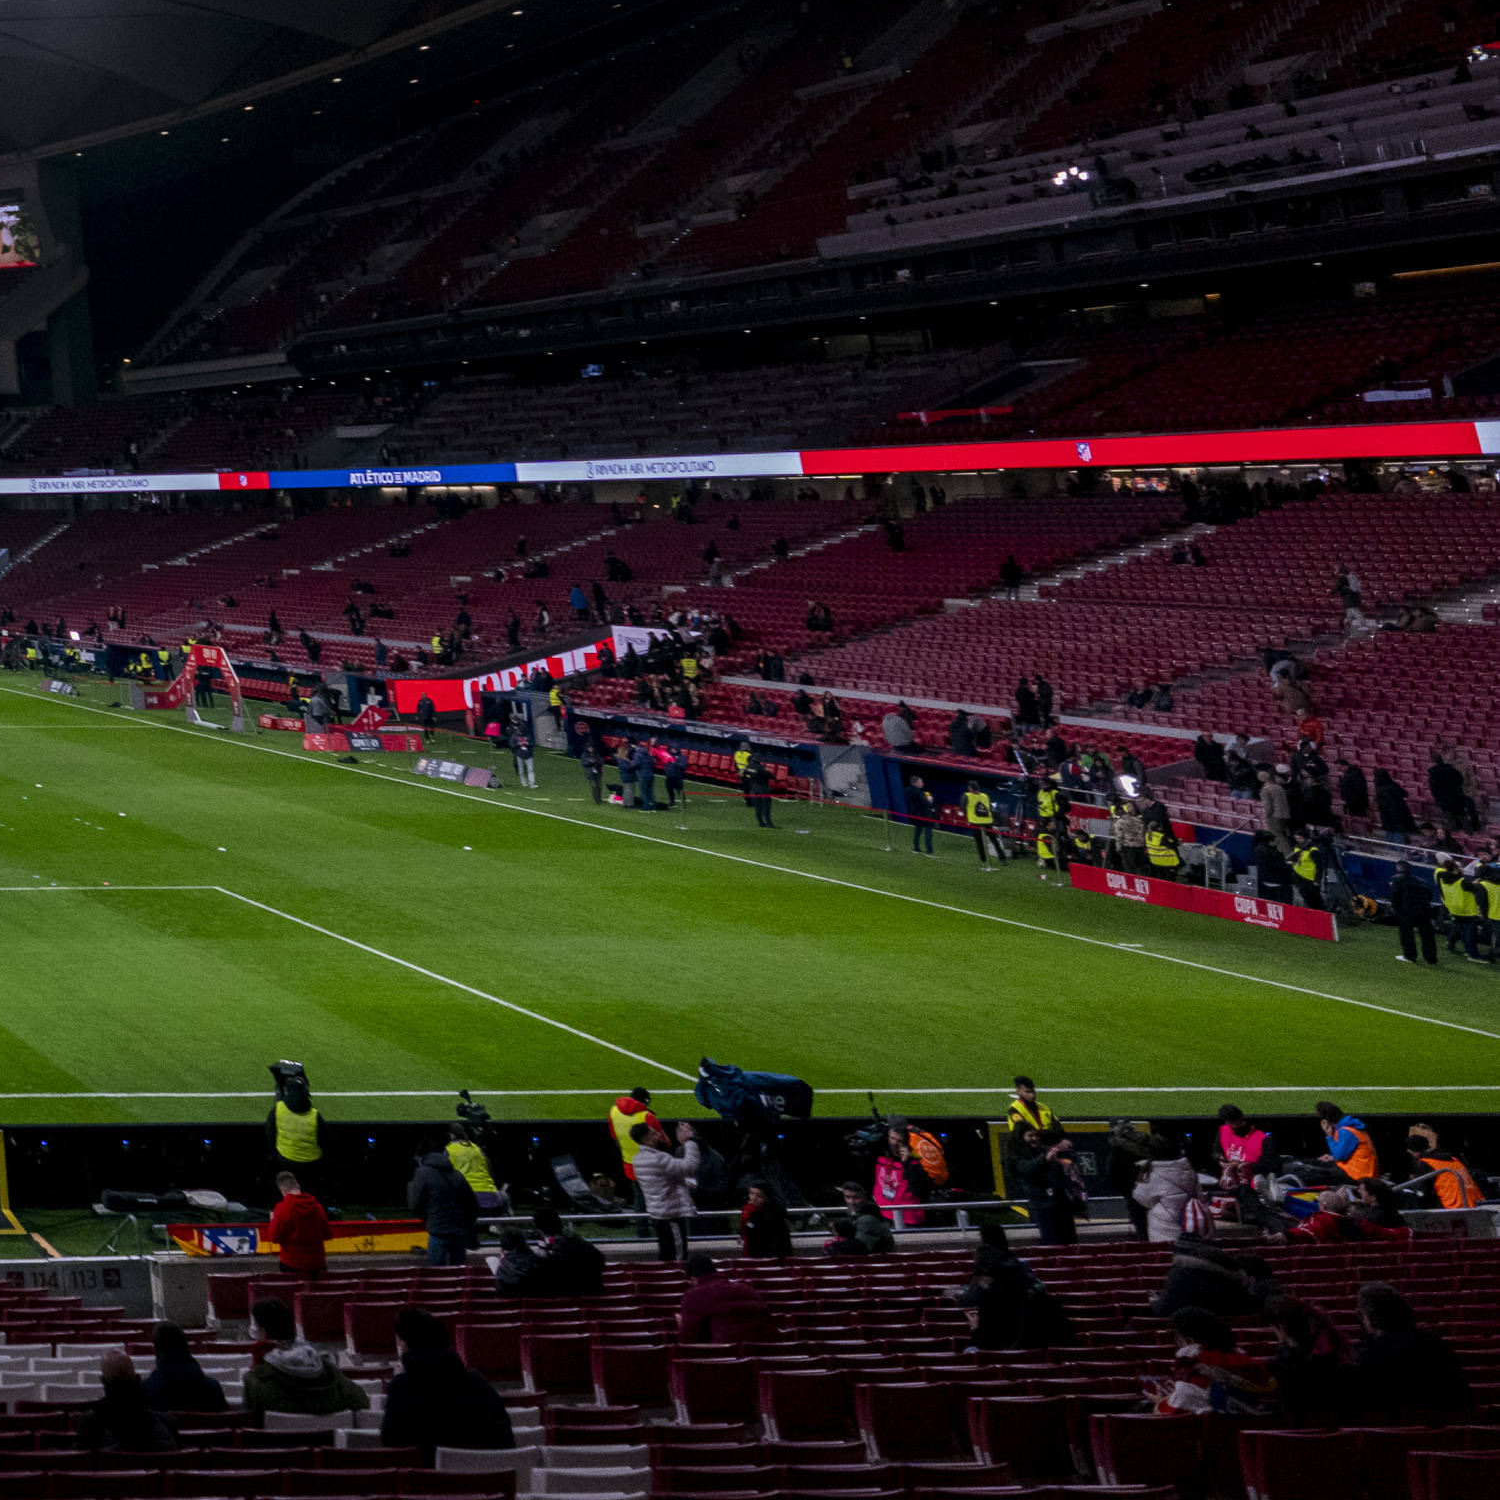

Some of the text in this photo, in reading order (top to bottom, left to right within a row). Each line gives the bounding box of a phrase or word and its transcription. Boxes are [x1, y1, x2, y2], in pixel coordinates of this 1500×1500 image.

[350, 470, 393, 486] ATLÉTICO
[403, 470, 441, 484] MADRID
[72, 1269, 97, 1289] 113
